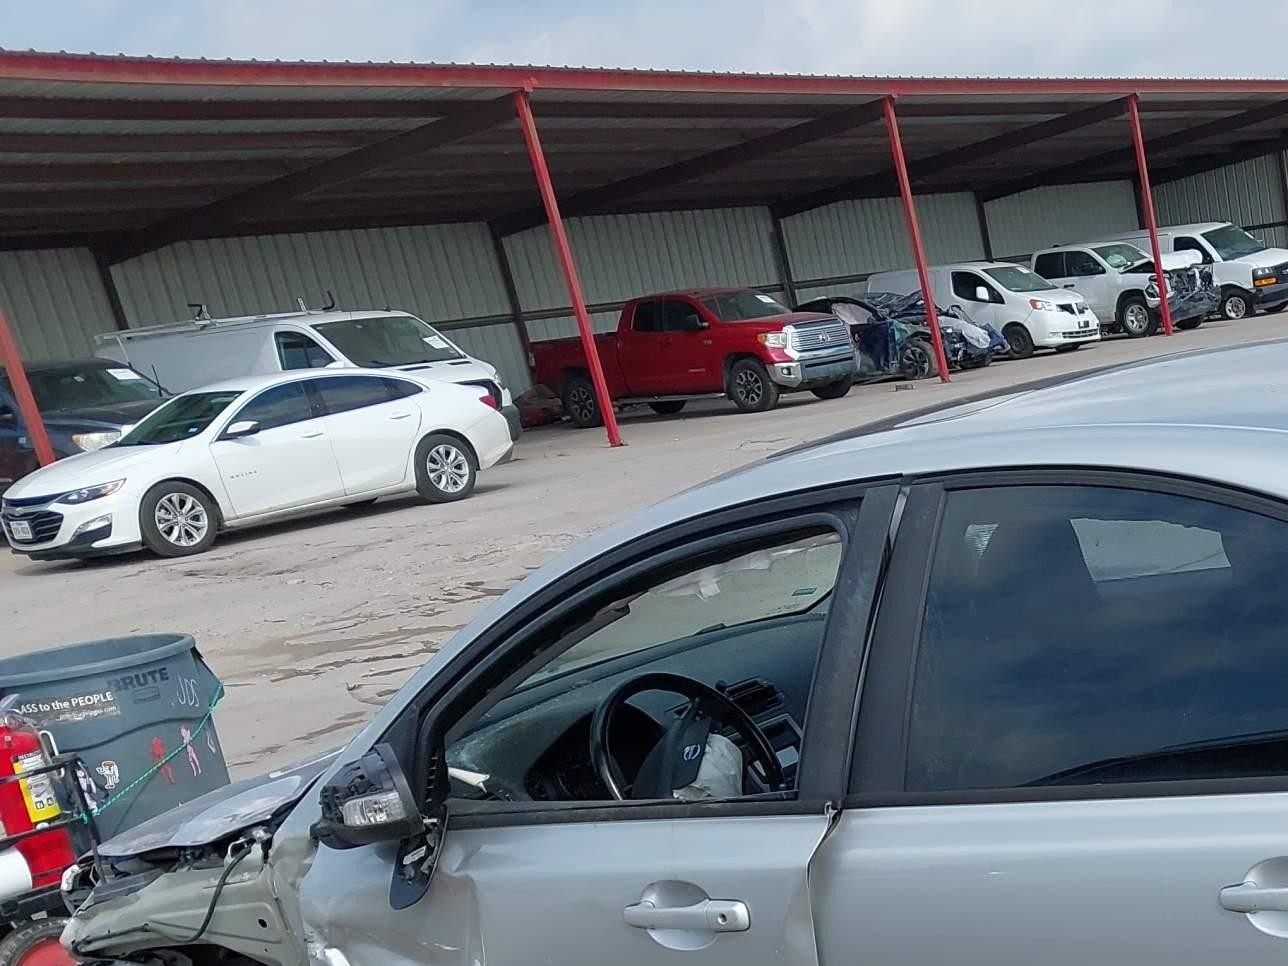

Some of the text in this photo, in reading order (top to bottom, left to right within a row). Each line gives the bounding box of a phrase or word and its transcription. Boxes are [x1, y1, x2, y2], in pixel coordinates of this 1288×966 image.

[107, 667, 169, 691] BRUTE
[39, 703, 50, 713] to
[51, 700, 70, 710] the
[71, 691, 114, 708] PEOPLE
